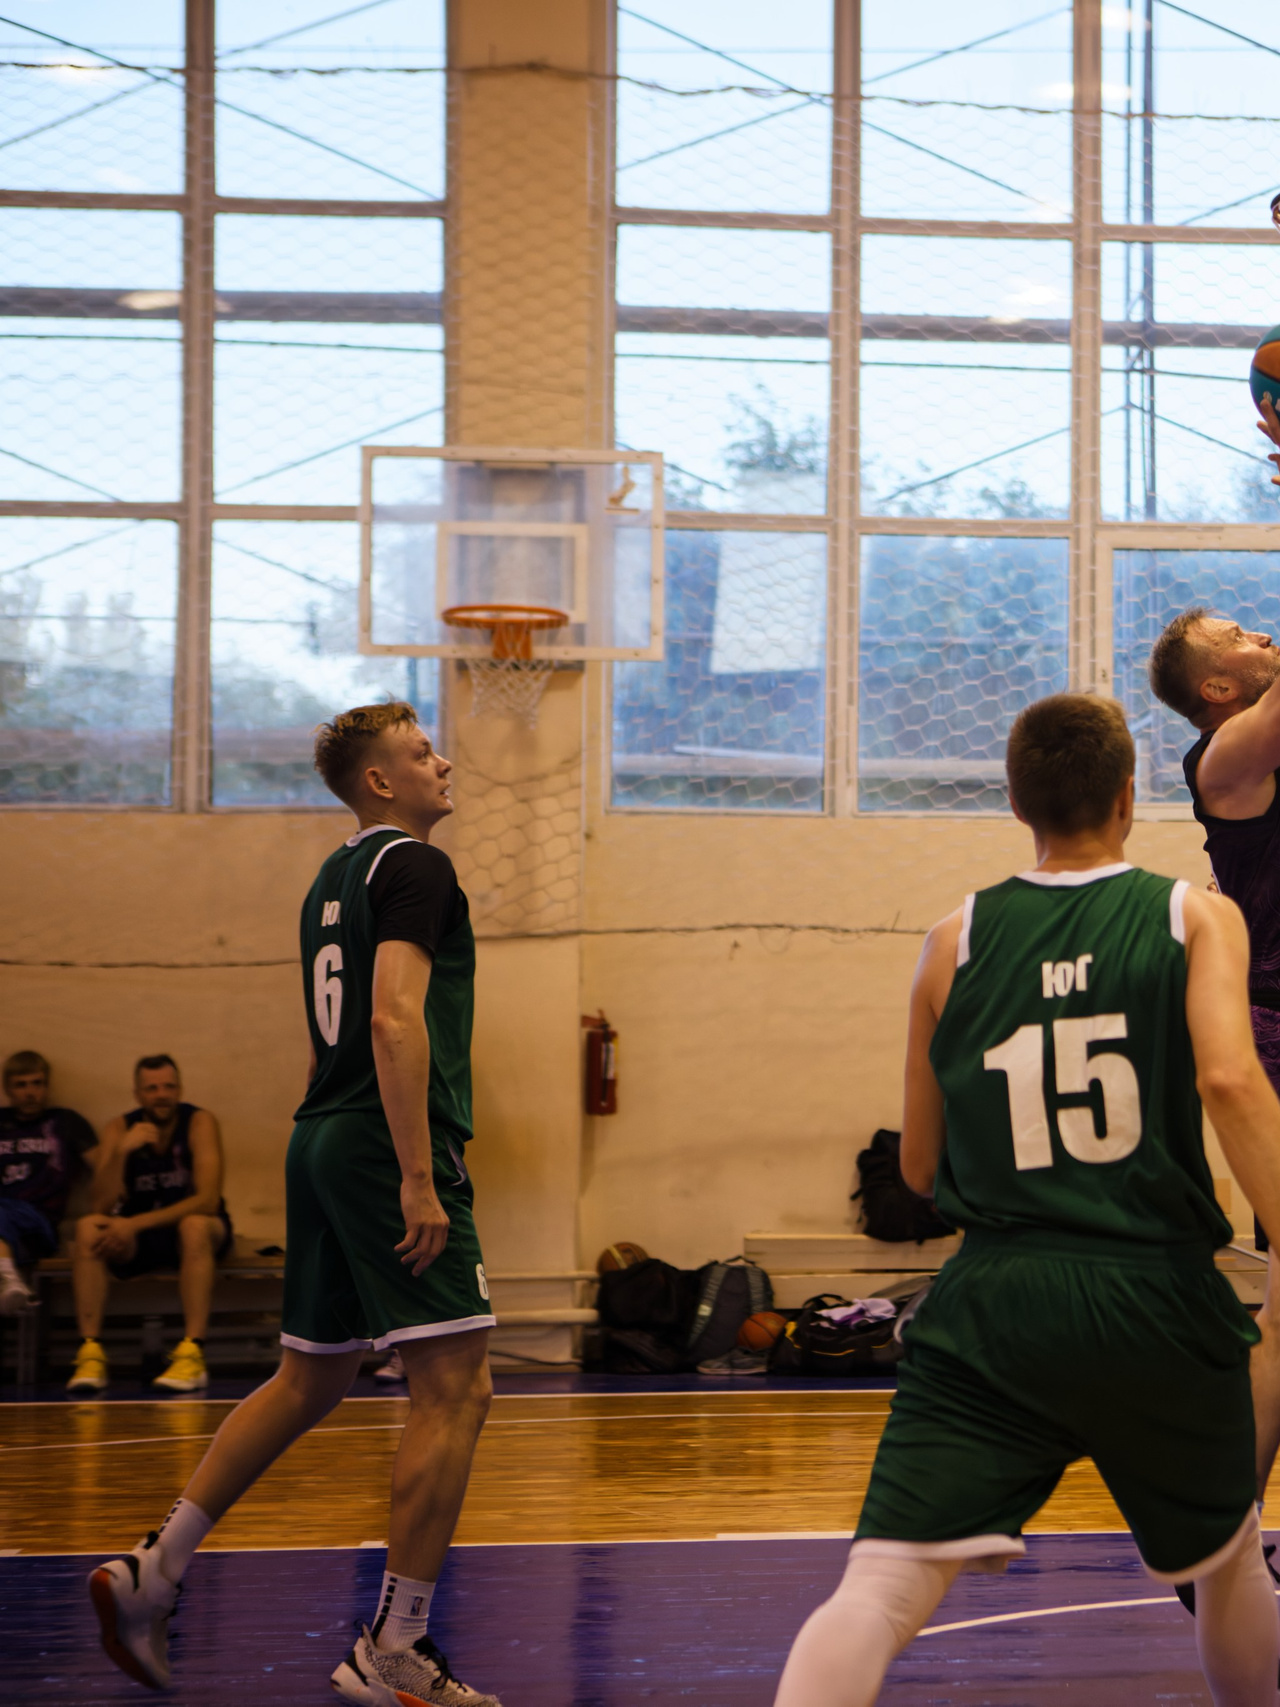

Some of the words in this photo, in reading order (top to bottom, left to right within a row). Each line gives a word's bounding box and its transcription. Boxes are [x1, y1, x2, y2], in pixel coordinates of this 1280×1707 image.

[313, 943, 344, 1047] 6
[1042, 953, 1093, 998] ЮГ
[983, 1012, 1142, 1171] 15
